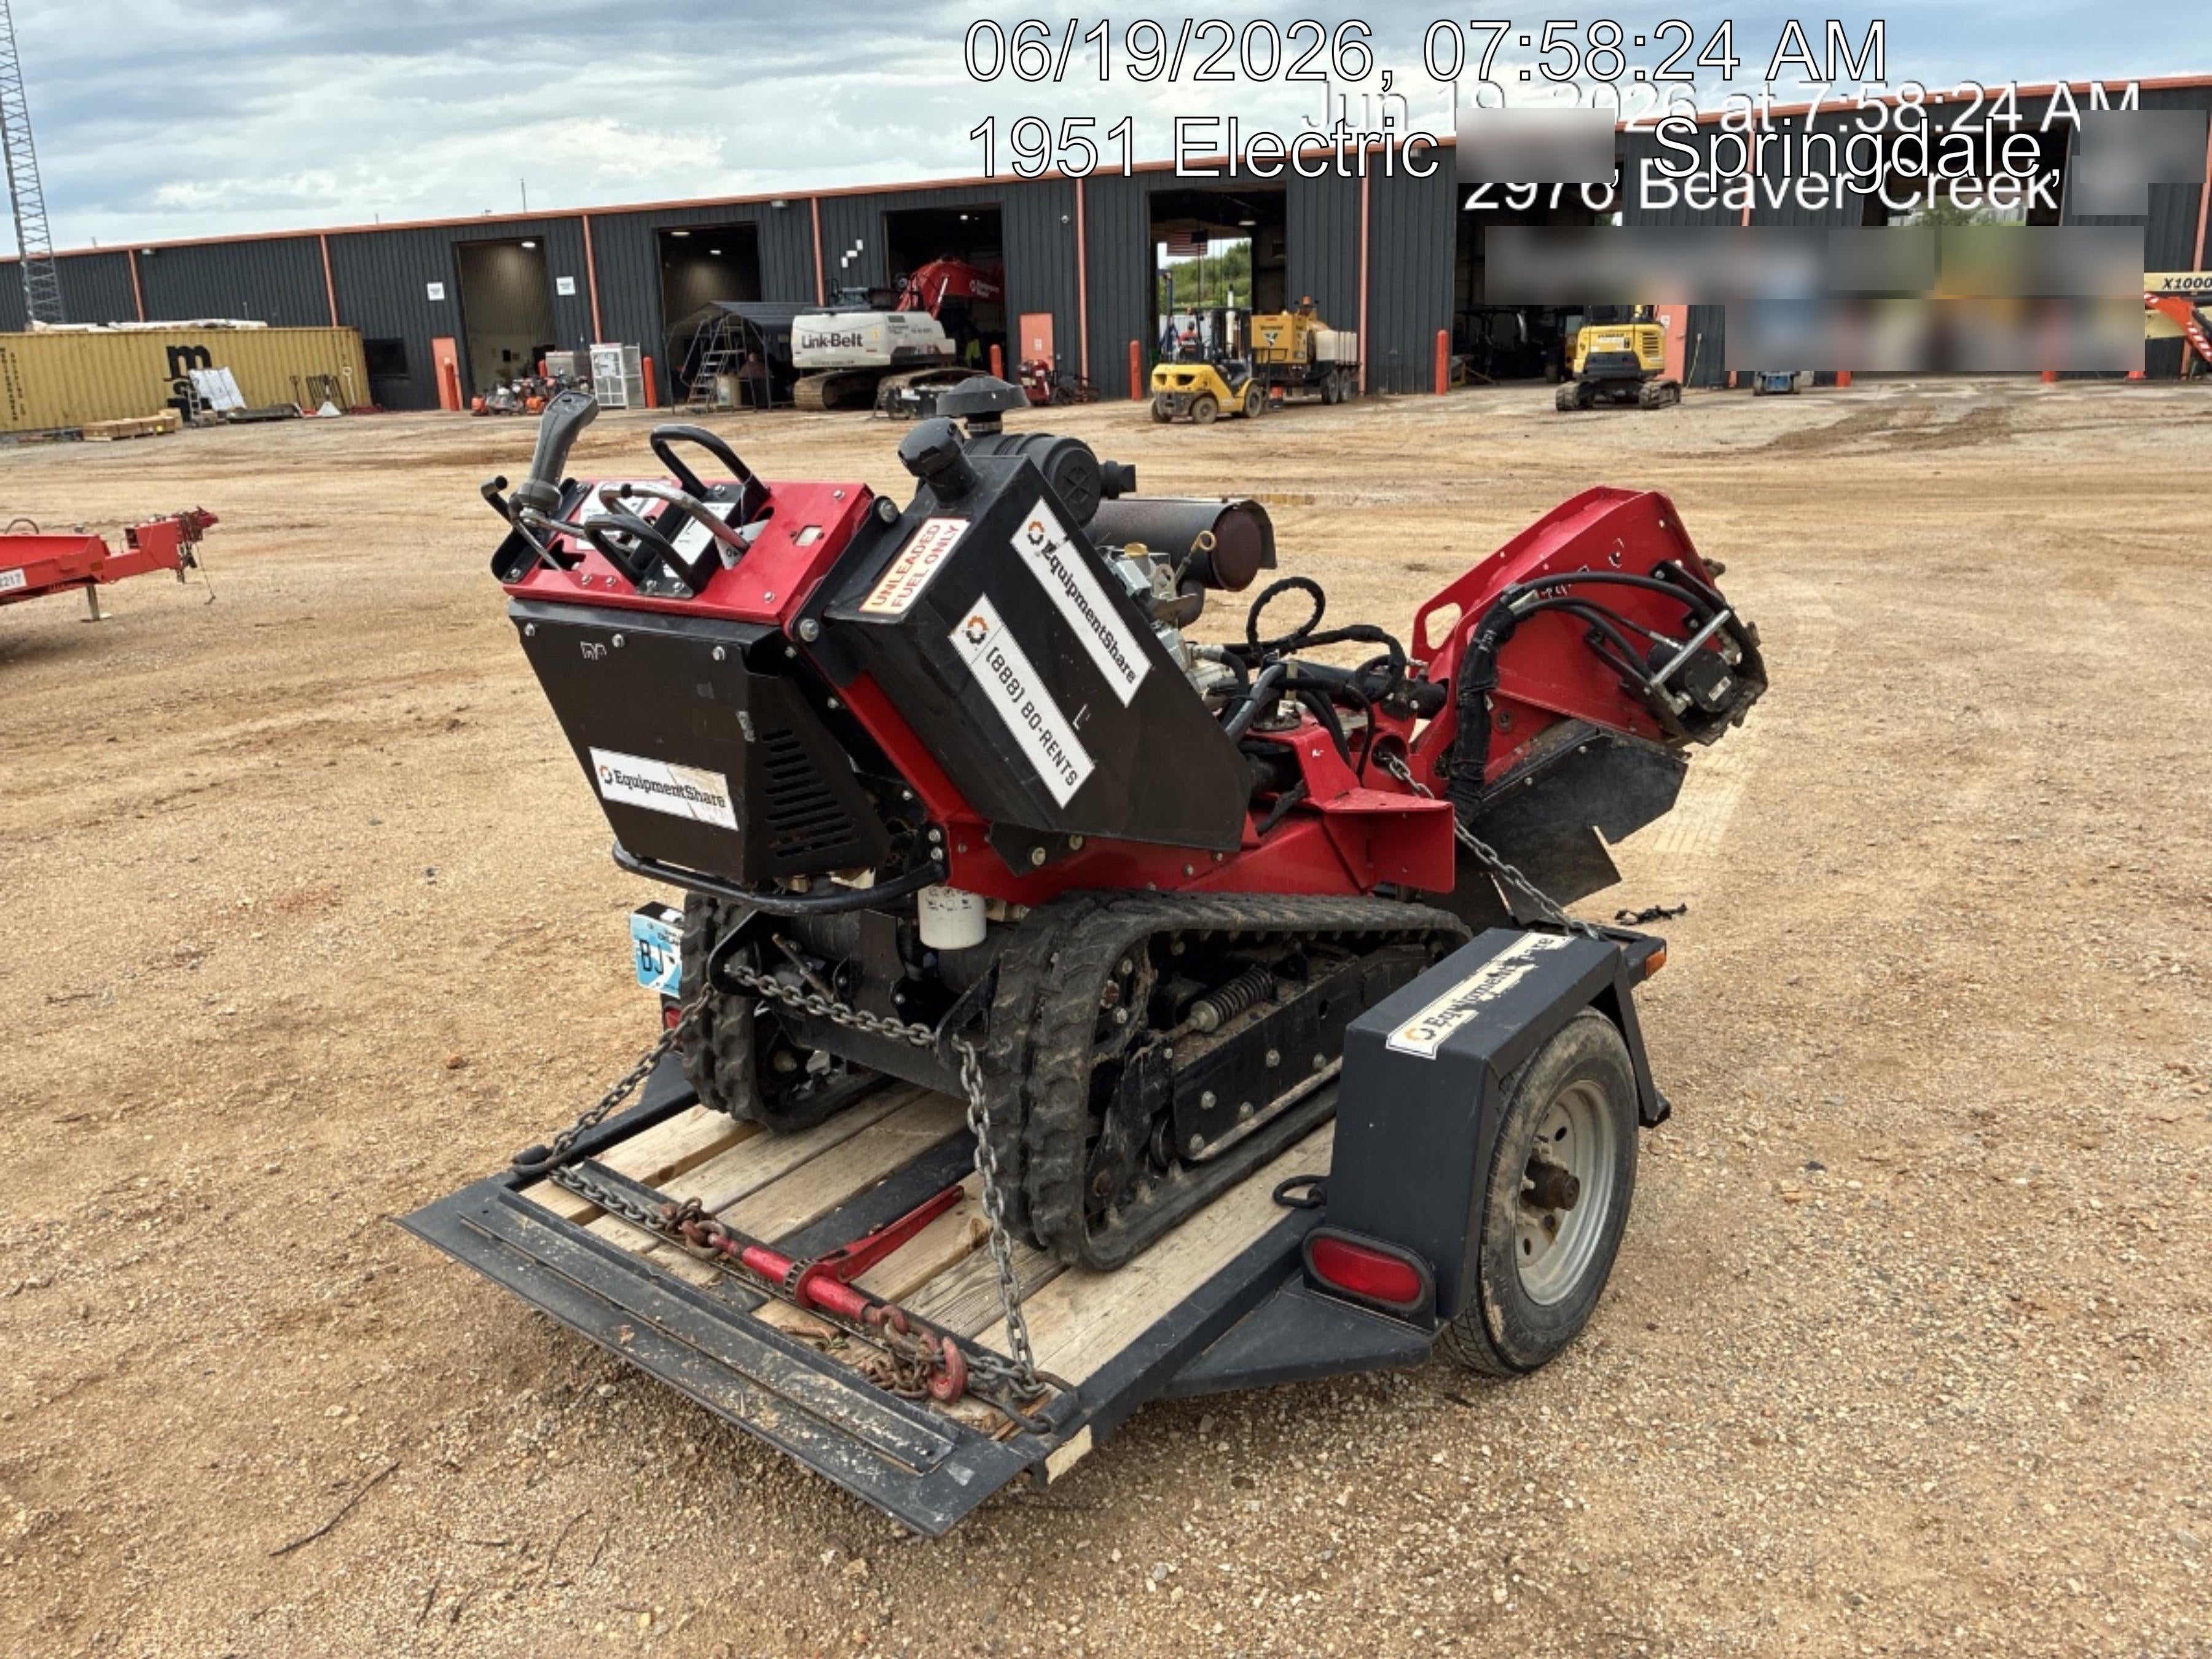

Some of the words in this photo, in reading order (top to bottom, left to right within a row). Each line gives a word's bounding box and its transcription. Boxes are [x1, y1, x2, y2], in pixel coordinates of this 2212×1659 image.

[801, 333, 863, 349] Link-Belt
[871, 525, 941, 605] UNLEADED
[890, 568, 929, 607] FUEL
[924, 525, 959, 564] ONLY
[1041, 539, 1135, 684] EquipmentShare
[986, 646, 1026, 703] (888)
[1021, 702, 1078, 786] 80-RENTS
[613, 768, 726, 807] EquipmentShare
